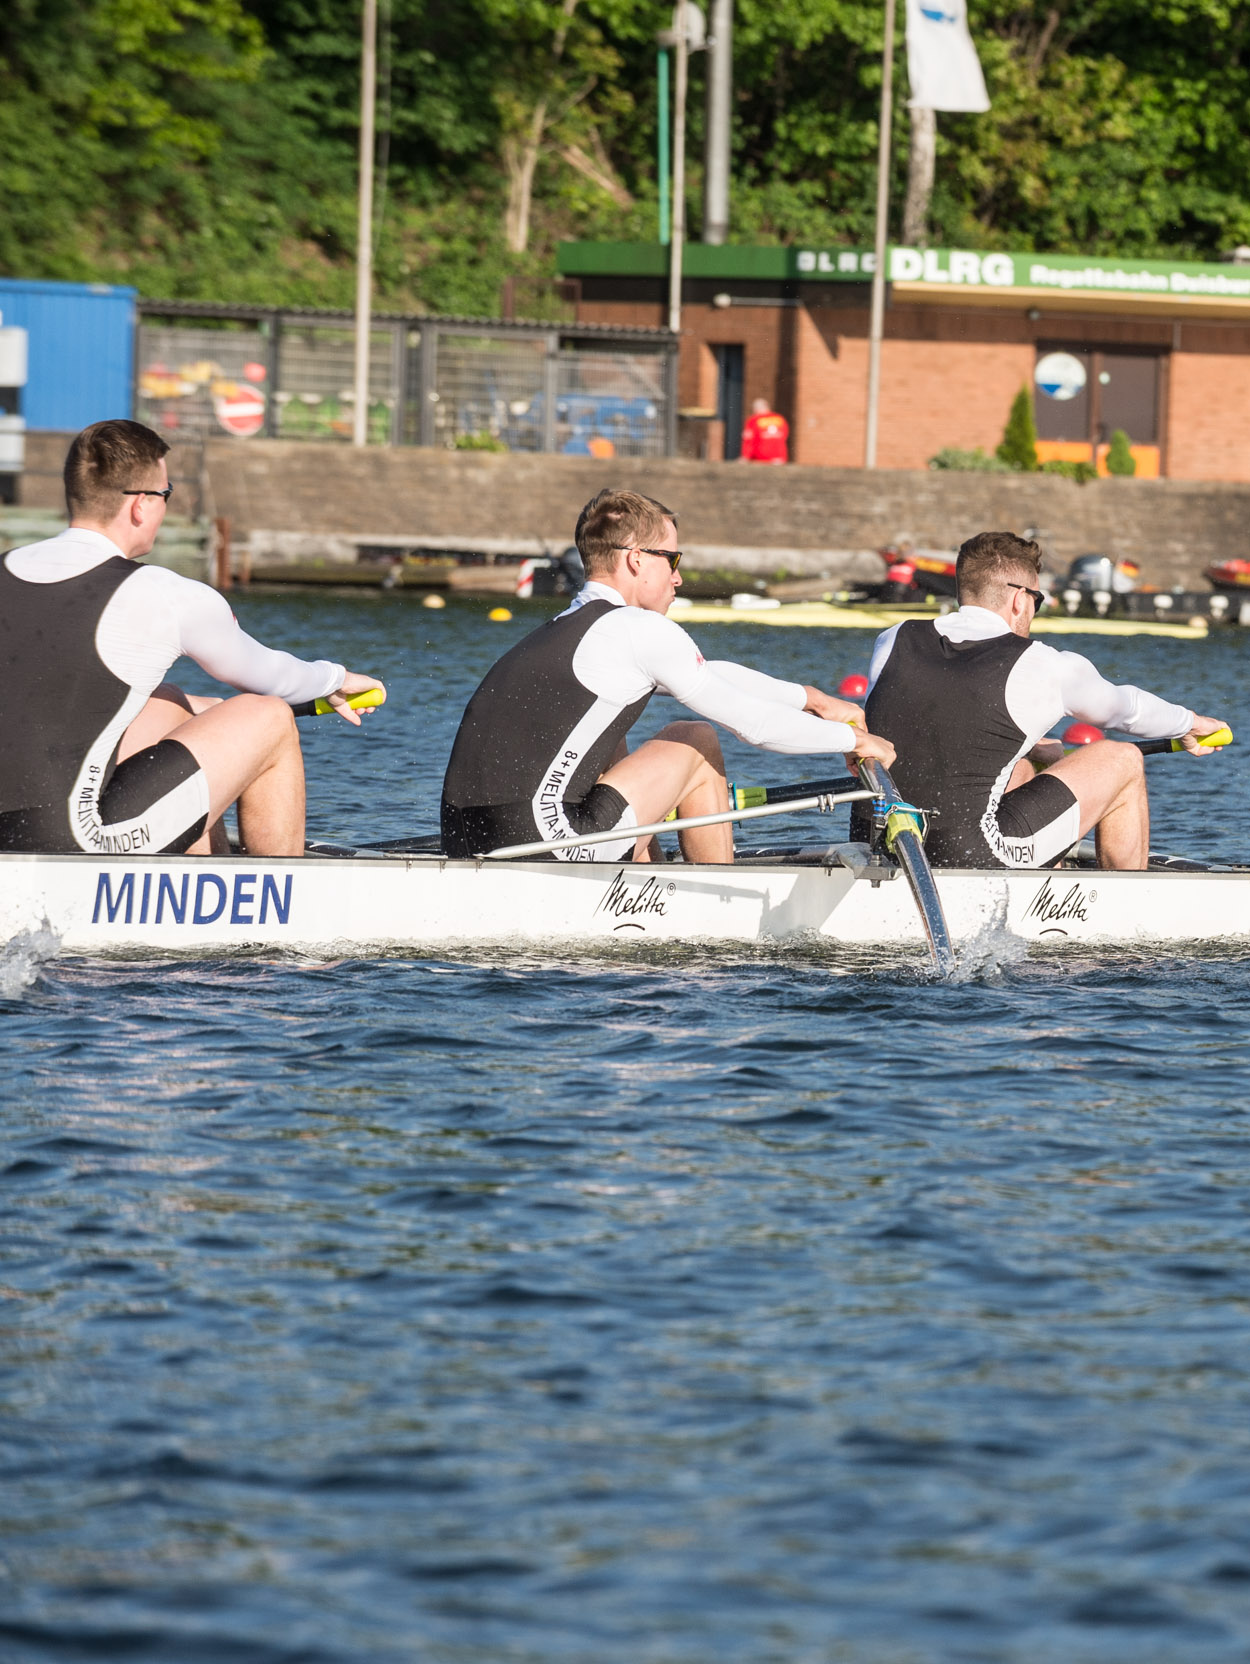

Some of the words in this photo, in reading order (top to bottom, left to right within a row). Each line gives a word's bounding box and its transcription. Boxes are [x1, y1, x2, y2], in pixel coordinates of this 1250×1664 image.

[889, 248, 1014, 286] DLRG
[88, 765, 101, 784] 8+
[561, 750, 578, 769] 8+
[540, 770, 596, 861] MELITTA-MNDEN
[91, 872, 294, 925] MINDEN
